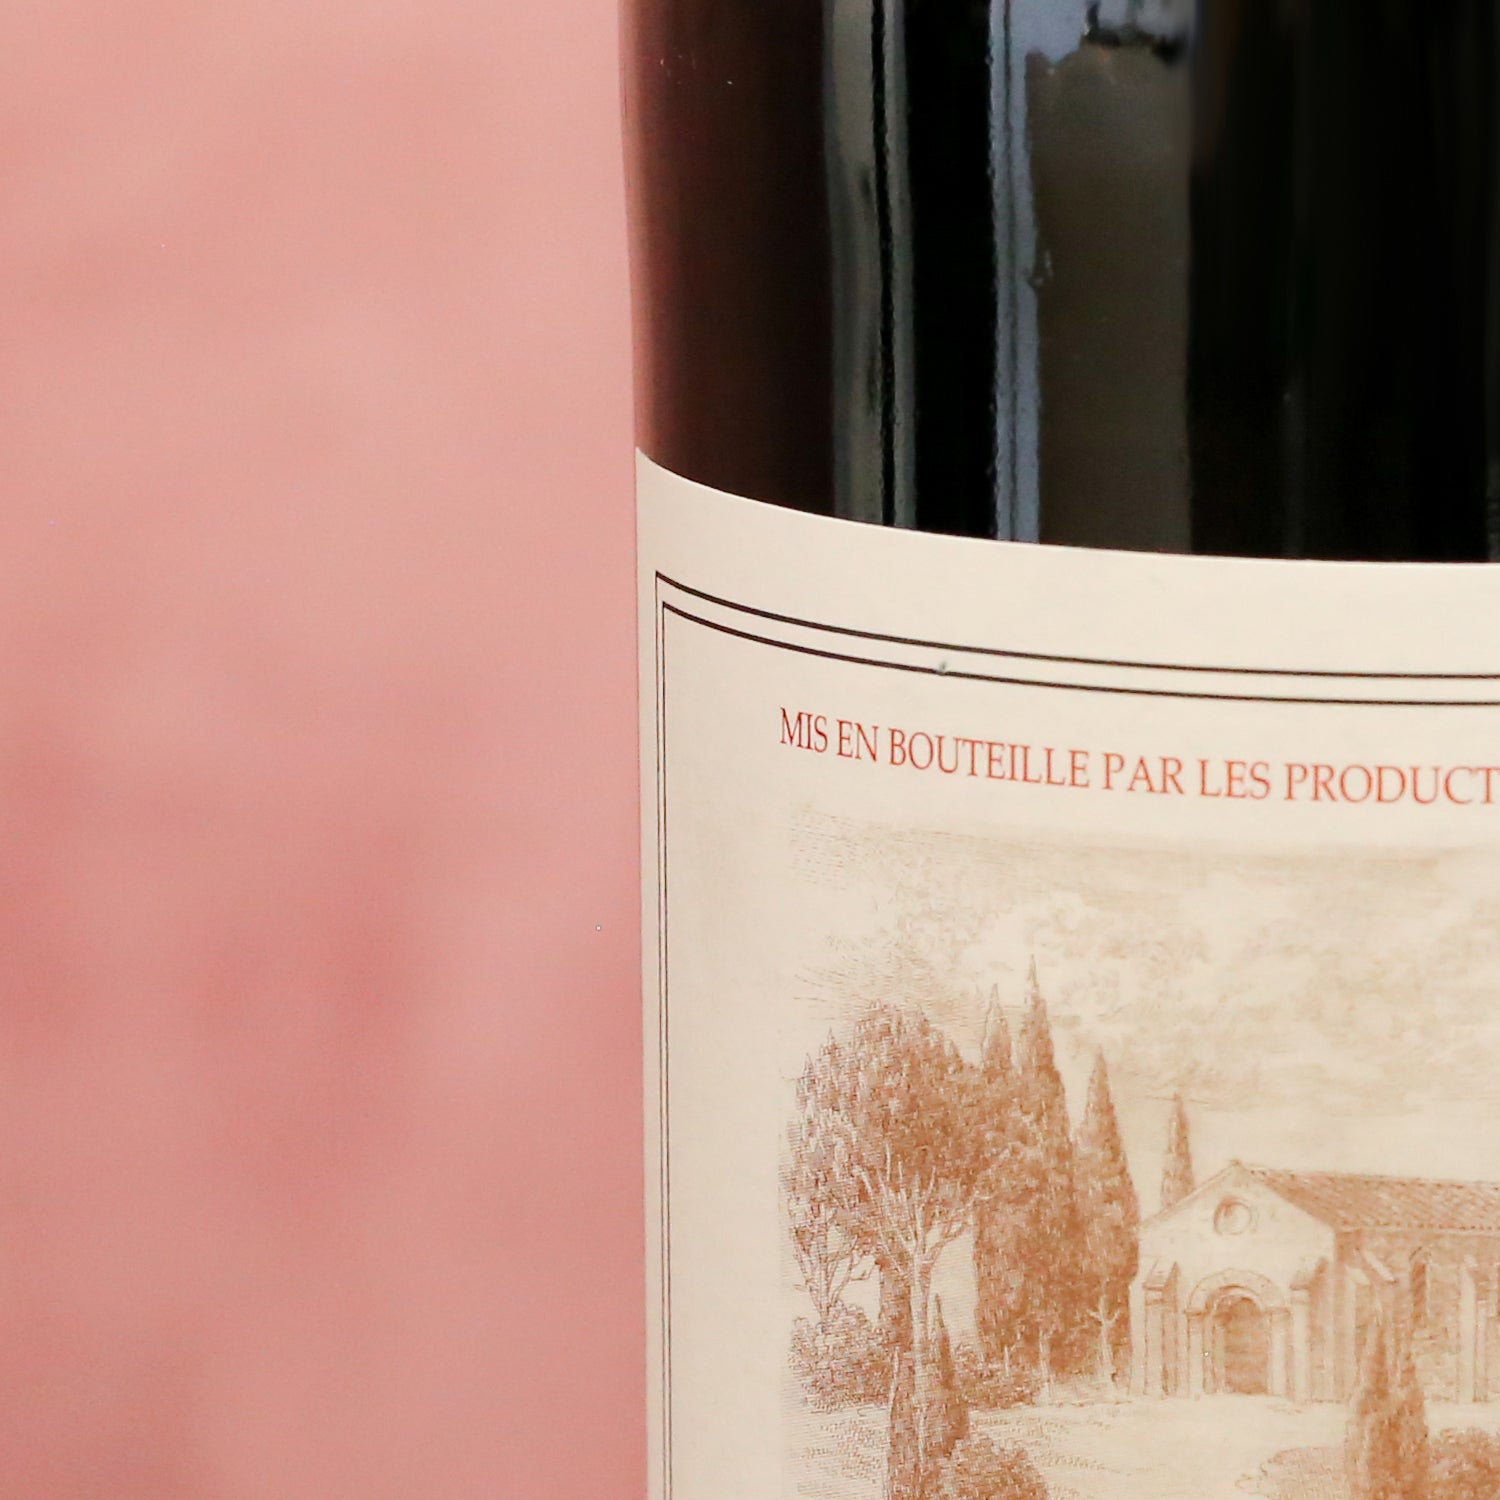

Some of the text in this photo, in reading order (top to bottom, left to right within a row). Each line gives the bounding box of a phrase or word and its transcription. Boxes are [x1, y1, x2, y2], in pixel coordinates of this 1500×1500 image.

[780, 707, 828, 753] MIS
[836, 719, 879, 762] EN
[887, 727, 1090, 788] BOUTEILLE
[1103, 752, 1185, 795] PAR
[1198, 759, 1271, 801] LES
